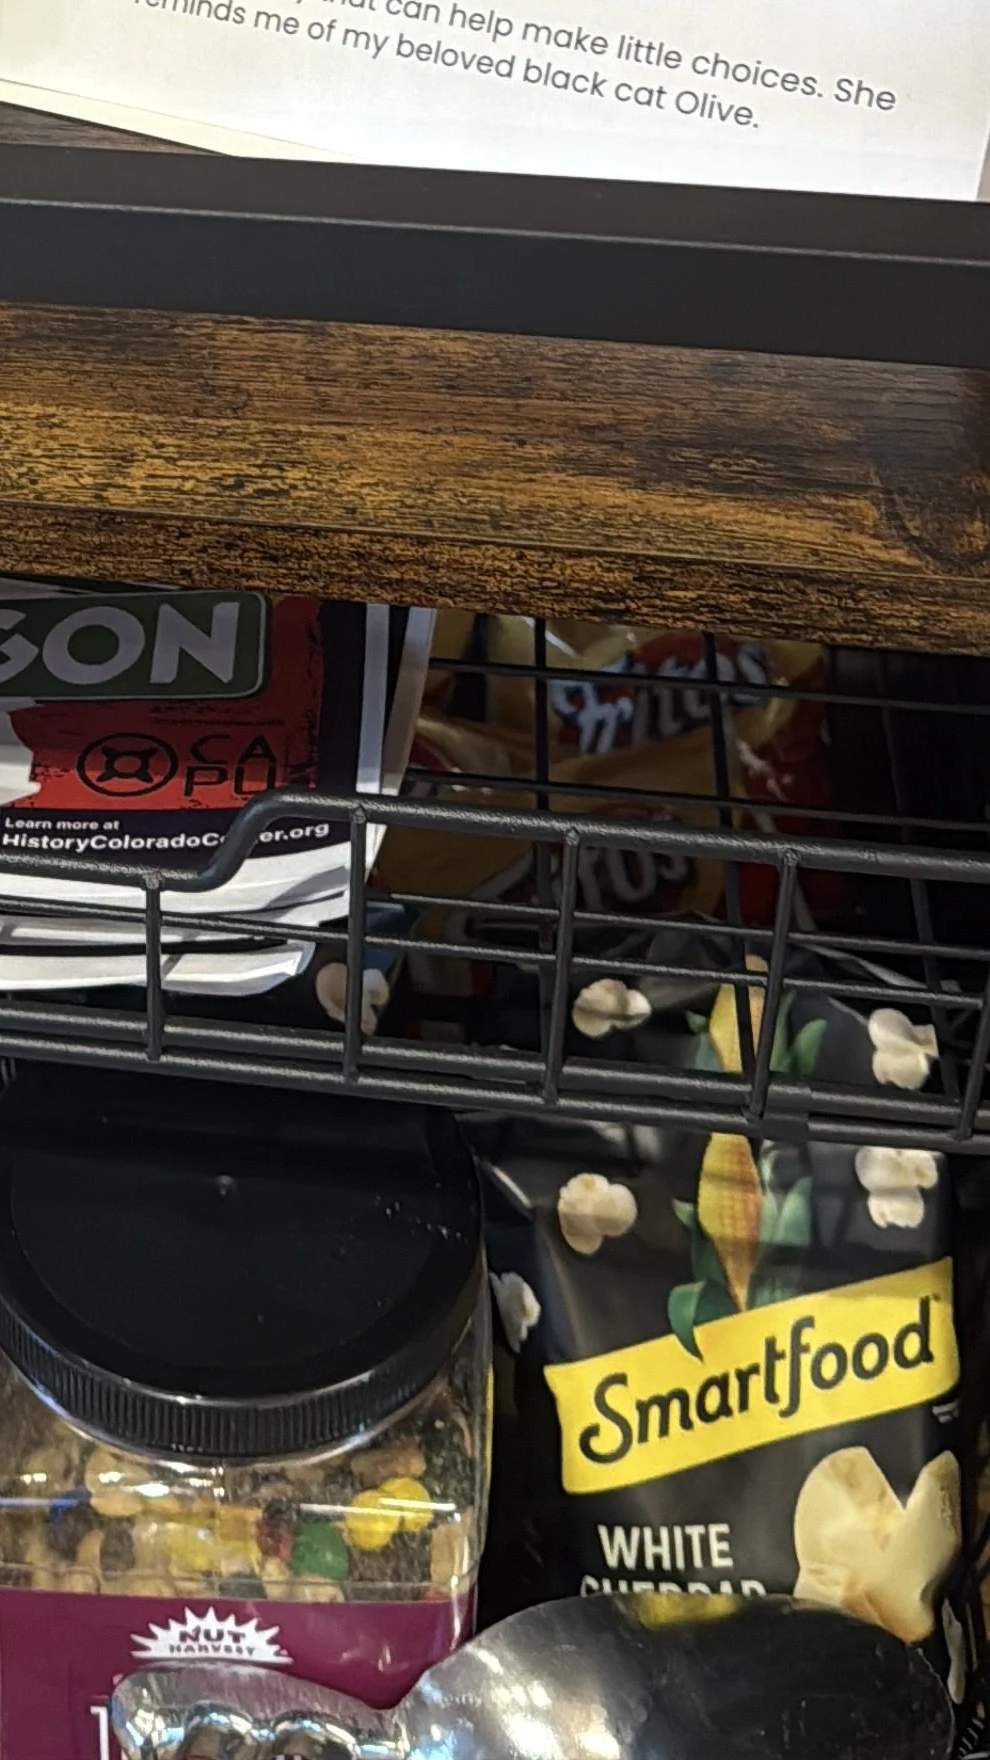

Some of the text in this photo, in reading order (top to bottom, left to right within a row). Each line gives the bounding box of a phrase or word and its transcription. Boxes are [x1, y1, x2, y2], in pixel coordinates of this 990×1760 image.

[253, 10, 300, 35] me
[306, 18, 338, 43] of
[341, 27, 390, 60] my
[395, 32, 517, 79] beloved
[522, 57, 609, 98] black
[613, 82, 668, 110] cat
[674, 89, 759, 129] Olive.
[448, 2, 514, 44] help
[521, 22, 609, 56] make
[616, 34, 683, 70] little
[690, 52, 824, 99] choices.
[833, 77, 897, 112] She
[5, 816, 120, 831] Learn more at
[578, 1294, 935, 1465] Smartfood
[597, 1522, 734, 1571] WHITE
[169, 1644, 257, 1657] HARVEST
[178, 1625, 247, 1643] NUT
